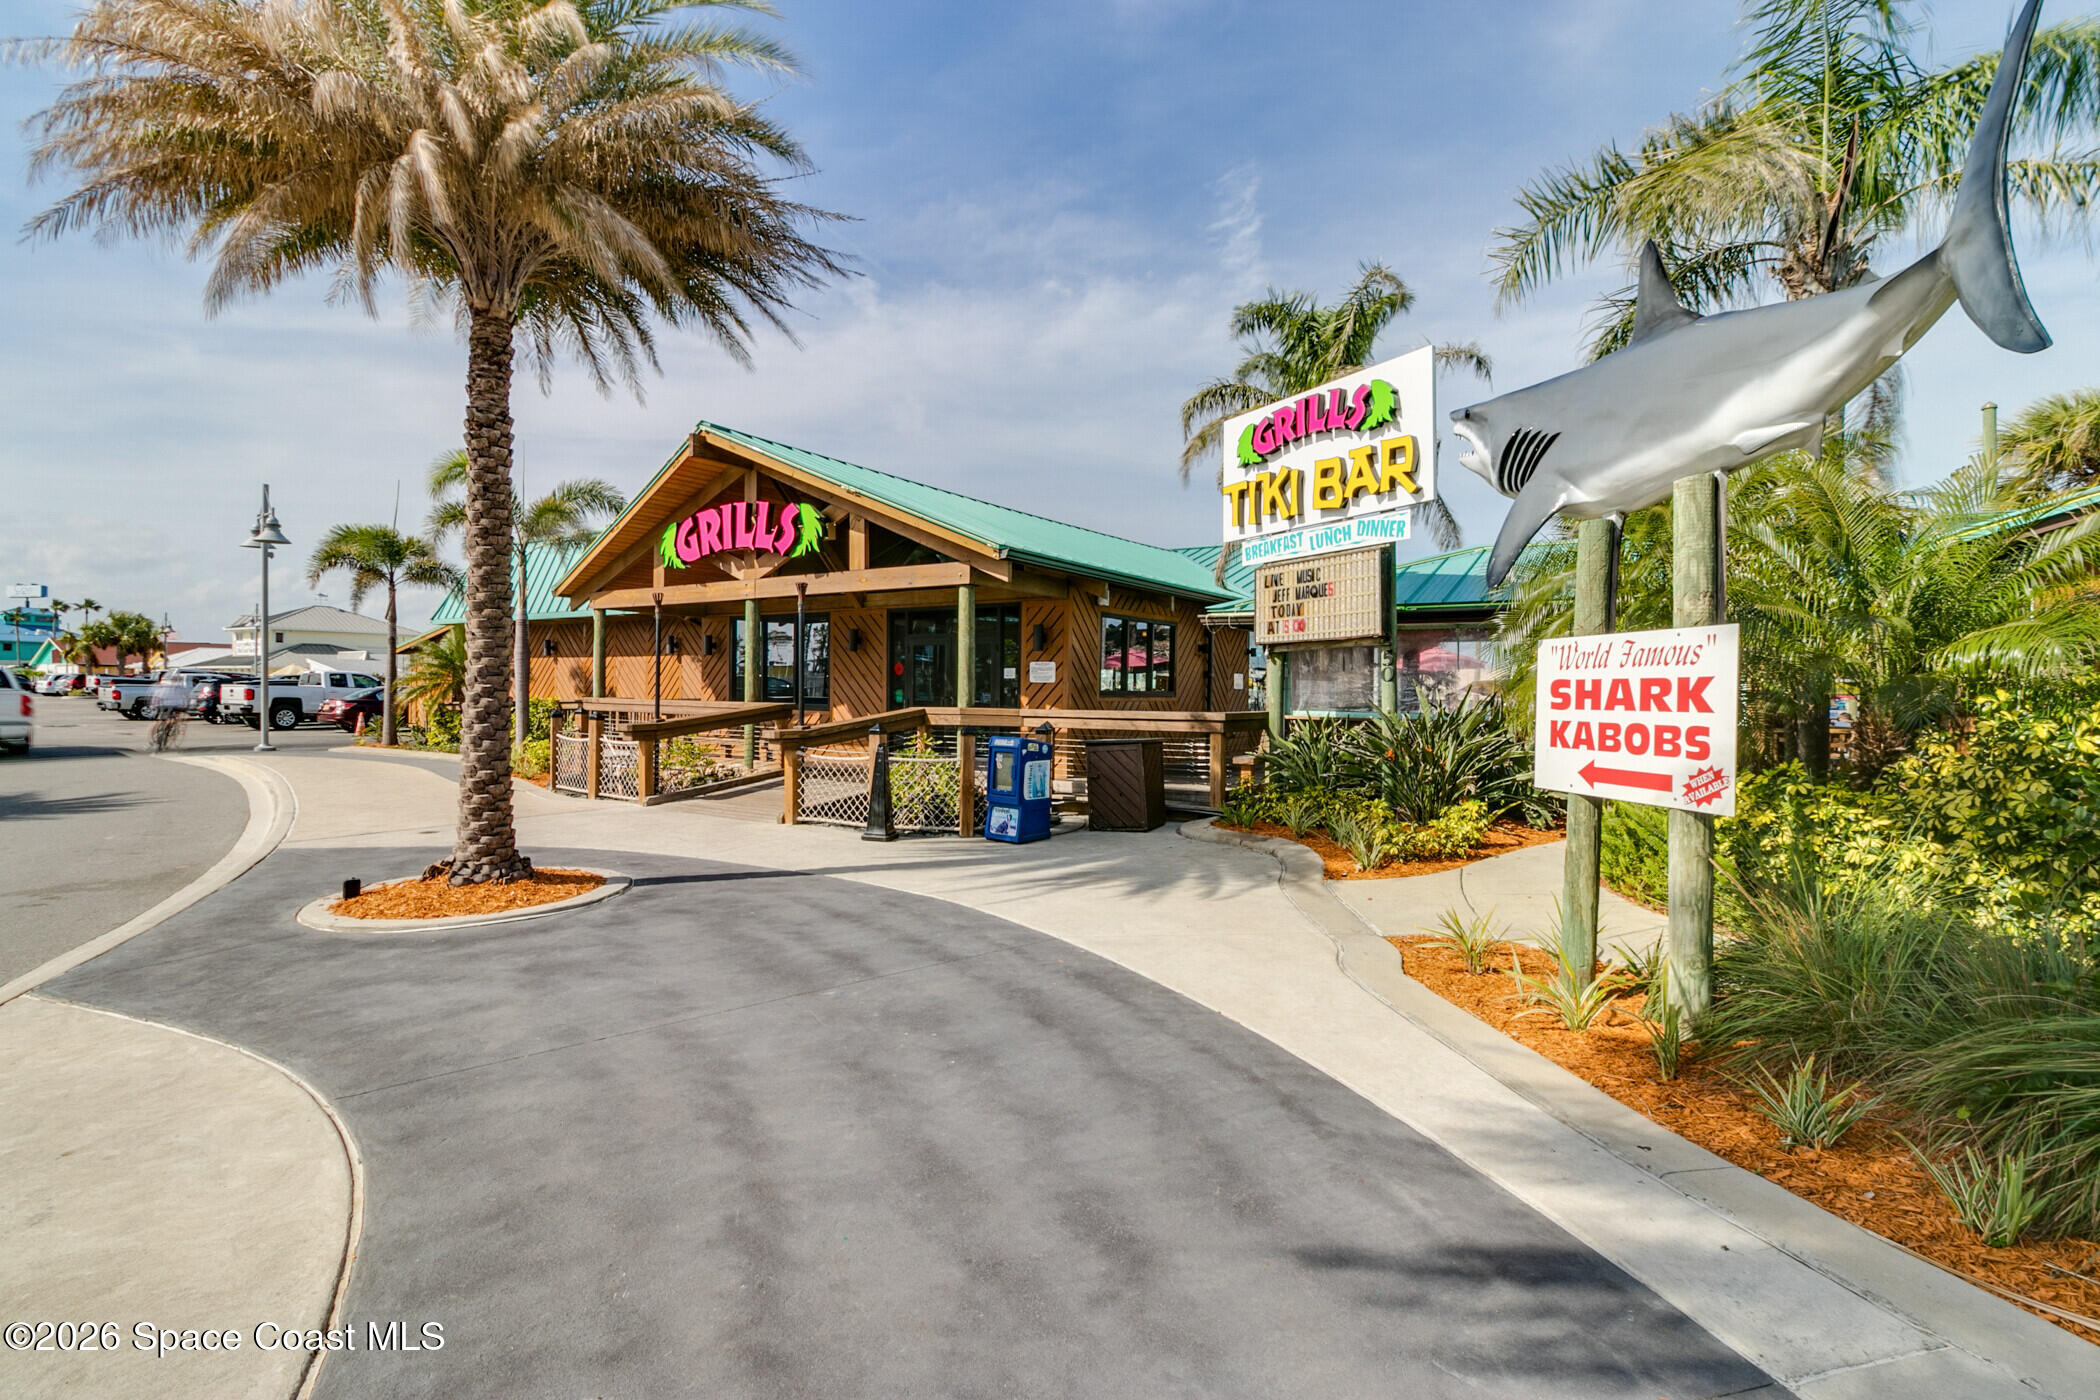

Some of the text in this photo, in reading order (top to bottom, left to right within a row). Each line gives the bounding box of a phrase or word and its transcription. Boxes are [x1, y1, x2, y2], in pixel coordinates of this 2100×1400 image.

[1253, 384, 1371, 454] GRILLS
[1222, 435, 1417, 526] TIKI BAR
[676, 501, 800, 562] GRILLS
[1245, 520, 1406, 561] BREAKFAST LUNCH DINNER
[1264, 568, 1320, 588] LIVE MUSIC
[1273, 588, 1290, 602] JEFF
[1267, 621, 1279, 635] AT
[1271, 602, 1304, 618] TODAY
[1550, 676, 1715, 713] SHARK
[1550, 720, 1710, 761] KABOBS
